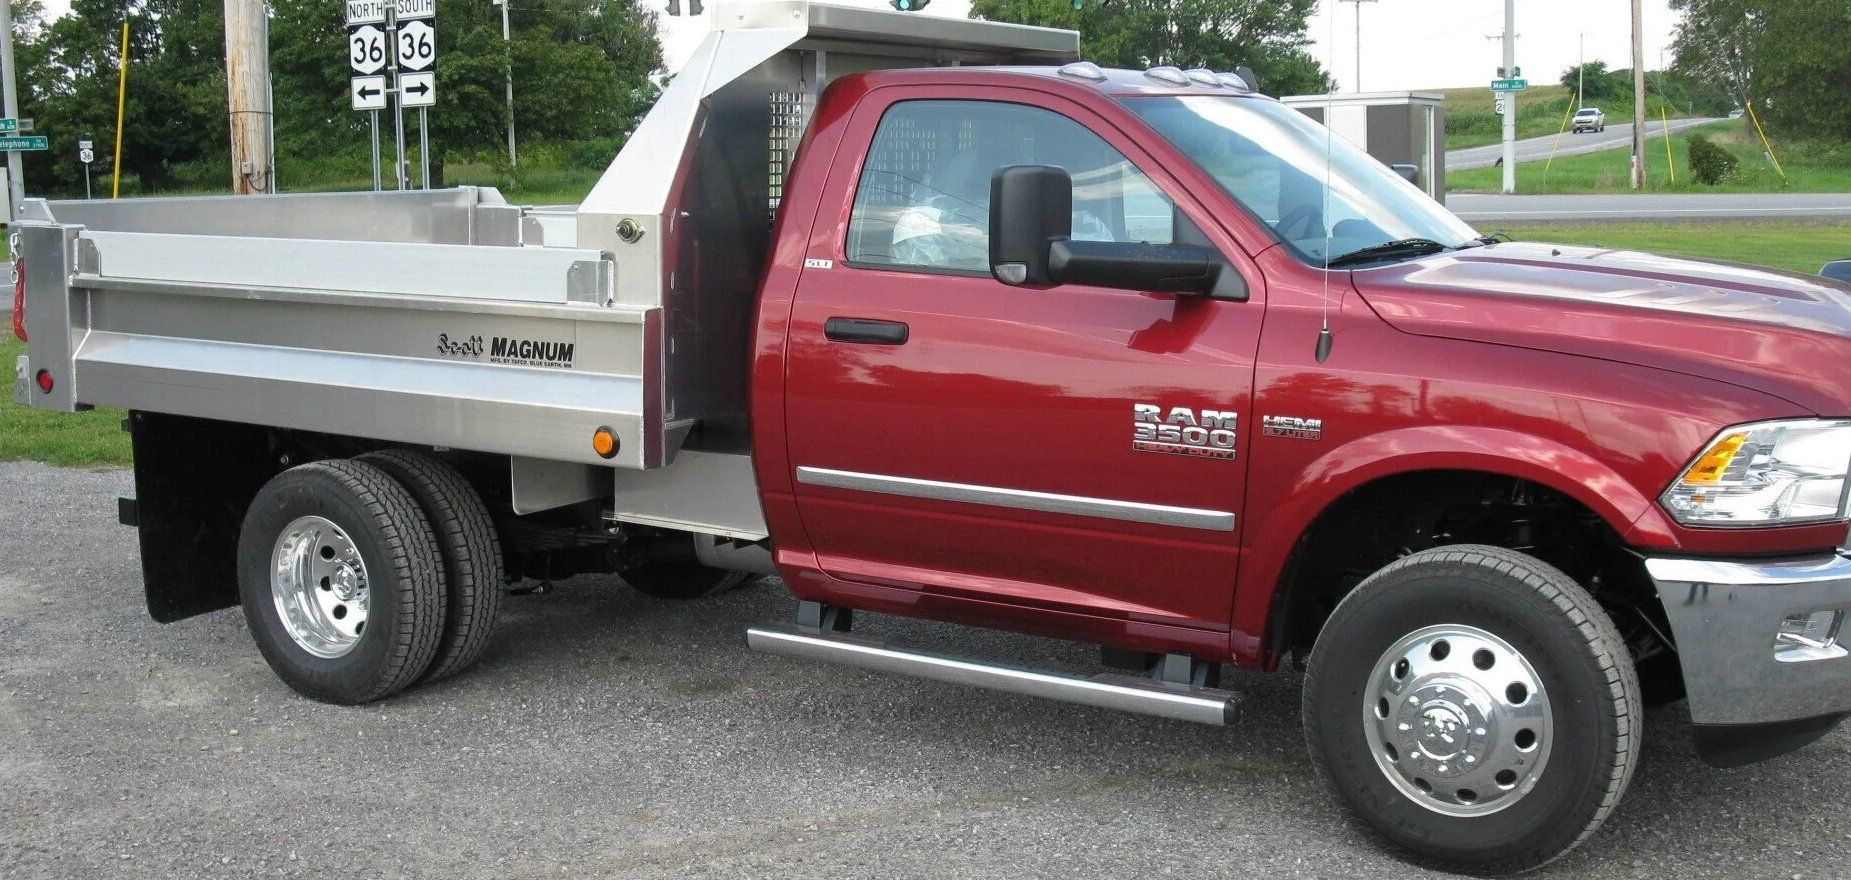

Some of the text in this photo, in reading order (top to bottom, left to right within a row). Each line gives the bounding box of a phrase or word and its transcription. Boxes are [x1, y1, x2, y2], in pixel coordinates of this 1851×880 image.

[349, 2, 383, 18] NORTH
[397, 0, 432, 13] SOUTH
[354, 36, 383, 64] 36
[402, 31, 432, 60] 36
[82, 151, 92, 160] 36
[437, 333, 575, 362] Scott MAGNUM
[1134, 403, 1238, 430] RAM
[1263, 415, 1322, 430] HEMI
[1134, 421, 1236, 448] 3500
